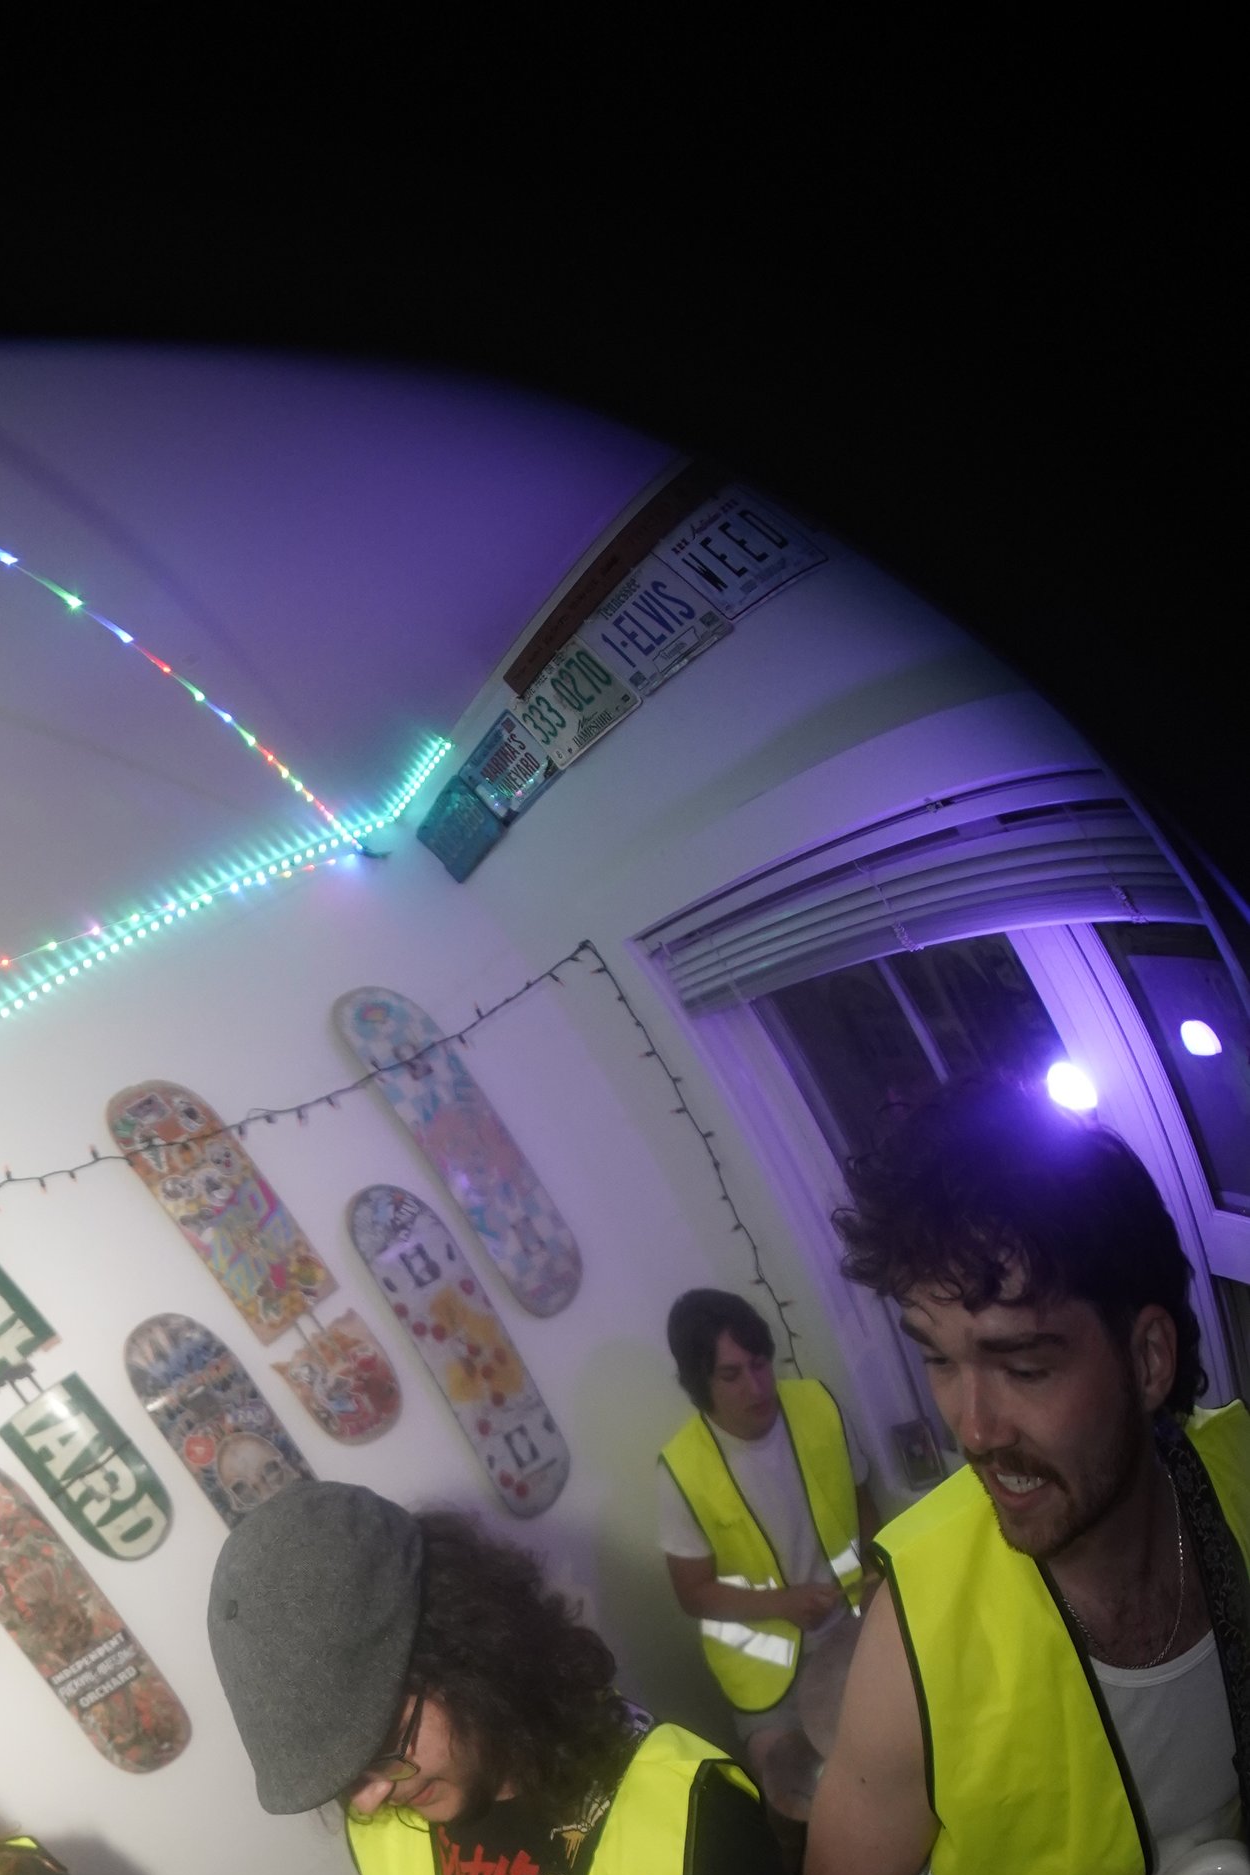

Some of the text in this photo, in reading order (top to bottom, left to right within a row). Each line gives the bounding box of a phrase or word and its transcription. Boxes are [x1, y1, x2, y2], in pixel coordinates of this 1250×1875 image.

[681, 509, 789, 592] WEED
[599, 577, 641, 620] Tennessee
[522, 695, 567, 746] 333
[551, 650, 612, 712] 0270
[572, 710, 613, 748] HAMPSHIRE
[481, 733, 527, 784] MARTHA'S
[496, 752, 541, 798] VINEYARD
[51, 1632, 125, 1685] INDEPENDENT
[79, 1665, 137, 1708] ORCHARD
